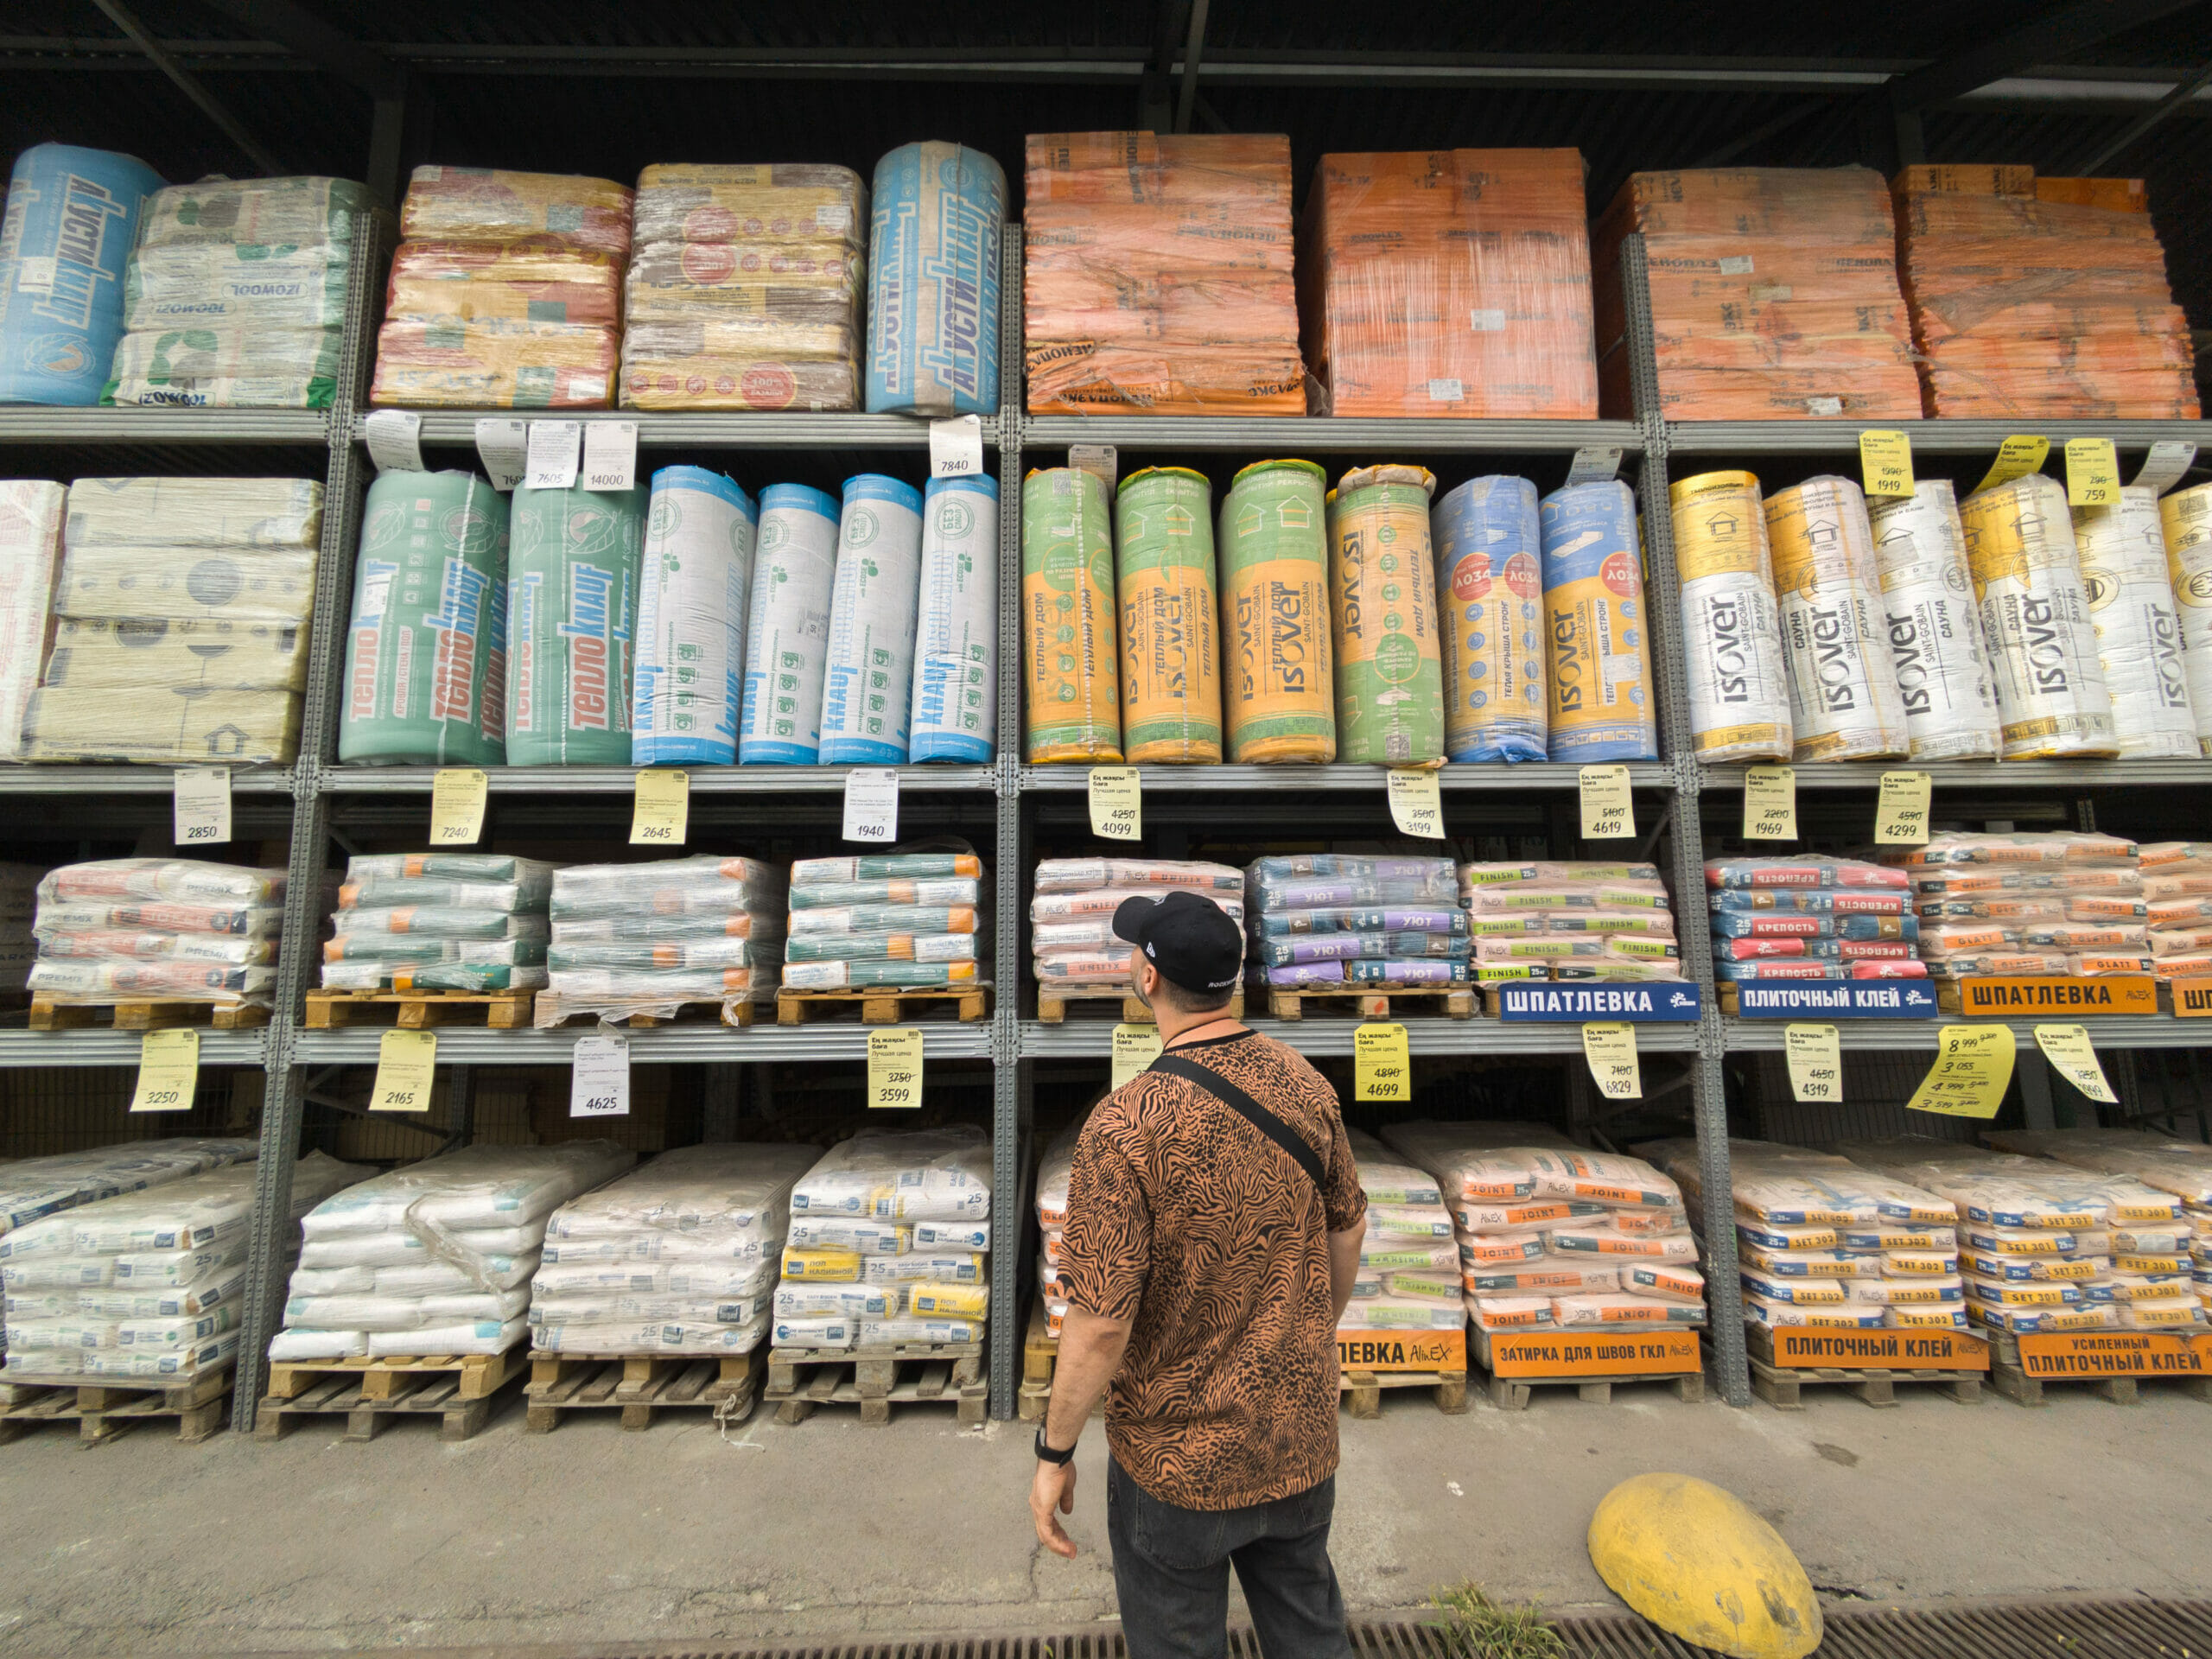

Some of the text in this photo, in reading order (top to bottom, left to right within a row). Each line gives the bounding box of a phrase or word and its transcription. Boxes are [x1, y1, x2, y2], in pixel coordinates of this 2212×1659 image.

[941, 460, 969, 472] 7840
[537, 473, 563, 484] 7605
[590, 474, 624, 486] 14000
[1877, 479, 1901, 492] 1919
[2084, 488, 2106, 501] 759
[944, 508, 954, 531] БЕЗ
[1035, 592, 1045, 625] ДОМ
[1154, 586, 1165, 619] ДОМ
[1185, 587, 1196, 649] SAINT-GOBAIN
[1303, 581, 1313, 644] SAINT-GOBAIN
[1596, 600, 1607, 635] СТРОНГ
[2008, 593, 2020, 632] САУНА
[1414, 604, 1426, 638] ДОМ
[1735, 591, 1753, 654] SAINT-GOBAIN
[1934, 600, 1953, 639] САУНА
[1500, 600, 1512, 669] КРЫША СТРОНГ
[1579, 601, 1591, 661] SAINT-GOBAIN
[1794, 610, 1807, 650] САУНА
[823, 664, 858, 732] KNAUF
[915, 658, 957, 726] KNAUF
[187, 826, 217, 838] 2850
[442, 826, 469, 839] 7240
[642, 826, 672, 838] 2645
[856, 825, 885, 837] 1940
[1101, 822, 1132, 836] 4099
[1406, 821, 1432, 834] 3199
[1592, 821, 1623, 834] 4619
[1755, 822, 1783, 836] 1969
[1885, 823, 1917, 837] 4299
[1395, 866, 1424, 876] УЮТ
[1480, 872, 1514, 880] FINISH
[1758, 874, 1815, 883] КРЕПОСТЬ
[1268, 891, 1281, 899] 25
[1306, 892, 1334, 902] УЮТ
[1839, 901, 1897, 911] КРЕПОСТЬ
[1403, 916, 1433, 926] УЮТ
[1453, 914, 1465, 923] 25
[1758, 923, 1815, 932] КРЕПОСТЬ
[1275, 946, 1288, 956] 25
[1313, 944, 1343, 957] УЮТ
[1622, 943, 1658, 953] FINISH
[1845, 947, 1904, 956] КРЕПОСТЬ
[1454, 965, 1465, 974] 25
[2096, 959, 2132, 969] GLATT
[1403, 968, 1433, 979] УЮТ
[1487, 969, 1522, 977] FINISH
[1764, 969, 1821, 977] КРЕПОСТЬ
[1506, 991, 1653, 1012] ШПАТЛЕВКА
[1745, 987, 1901, 1007] ПЛИТОЧНЫЙ КЛЕЙ
[1972, 985, 2113, 1006] ШПАТЛЕВКА
[1948, 1039, 1960, 1052] 8
[1367, 1083, 1399, 1097] 4699
[1605, 1080, 1632, 1094] 6829
[1802, 1083, 1829, 1096] 4319
[144, 1091, 179, 1104] 3250
[385, 1091, 414, 1105] 2165
[879, 1089, 910, 1103] 3599
[586, 1096, 618, 1109] 4625
[968, 1192, 982, 1204] 25
[1592, 1188, 1626, 1199] JOINT
[1522, 1209, 1555, 1219] JOINT
[2048, 1217, 2066, 1226] SET
[793, 1227, 808, 1237] 25
[1796, 1236, 1834, 1248] SET 302
[1886, 1238, 1928, 1247] SET 302
[2006, 1243, 2028, 1252] SET
[870, 1263, 886, 1274] 25
[1897, 1261, 1939, 1271] SET 302
[2126, 1260, 2146, 1269] SET
[809, 1267, 853, 1275] НАЛИВНОЙ
[779, 1294, 794, 1305] 25
[2012, 1293, 2034, 1302] SET
[1493, 1314, 1527, 1325] JOINT
[1904, 1316, 1948, 1325] SET 302
[1786, 1335, 1898, 1357] ПЛИТОЧНЫЙ
[1905, 1336, 1953, 1357] КЛЕЙ
[2071, 1336, 2151, 1351] УСИЛЕННЫЙ
[1500, 1346, 1559, 1363] ЗАТИРКА
[1563, 1345, 1592, 1363] ДЛЯ
[1597, 1344, 1636, 1361] ШВОВ
[1640, 1344, 1666, 1358] ГКЛ
[2027, 1350, 2202, 1372] ПЛИТОЧНЫЙ КЛЕЙ
